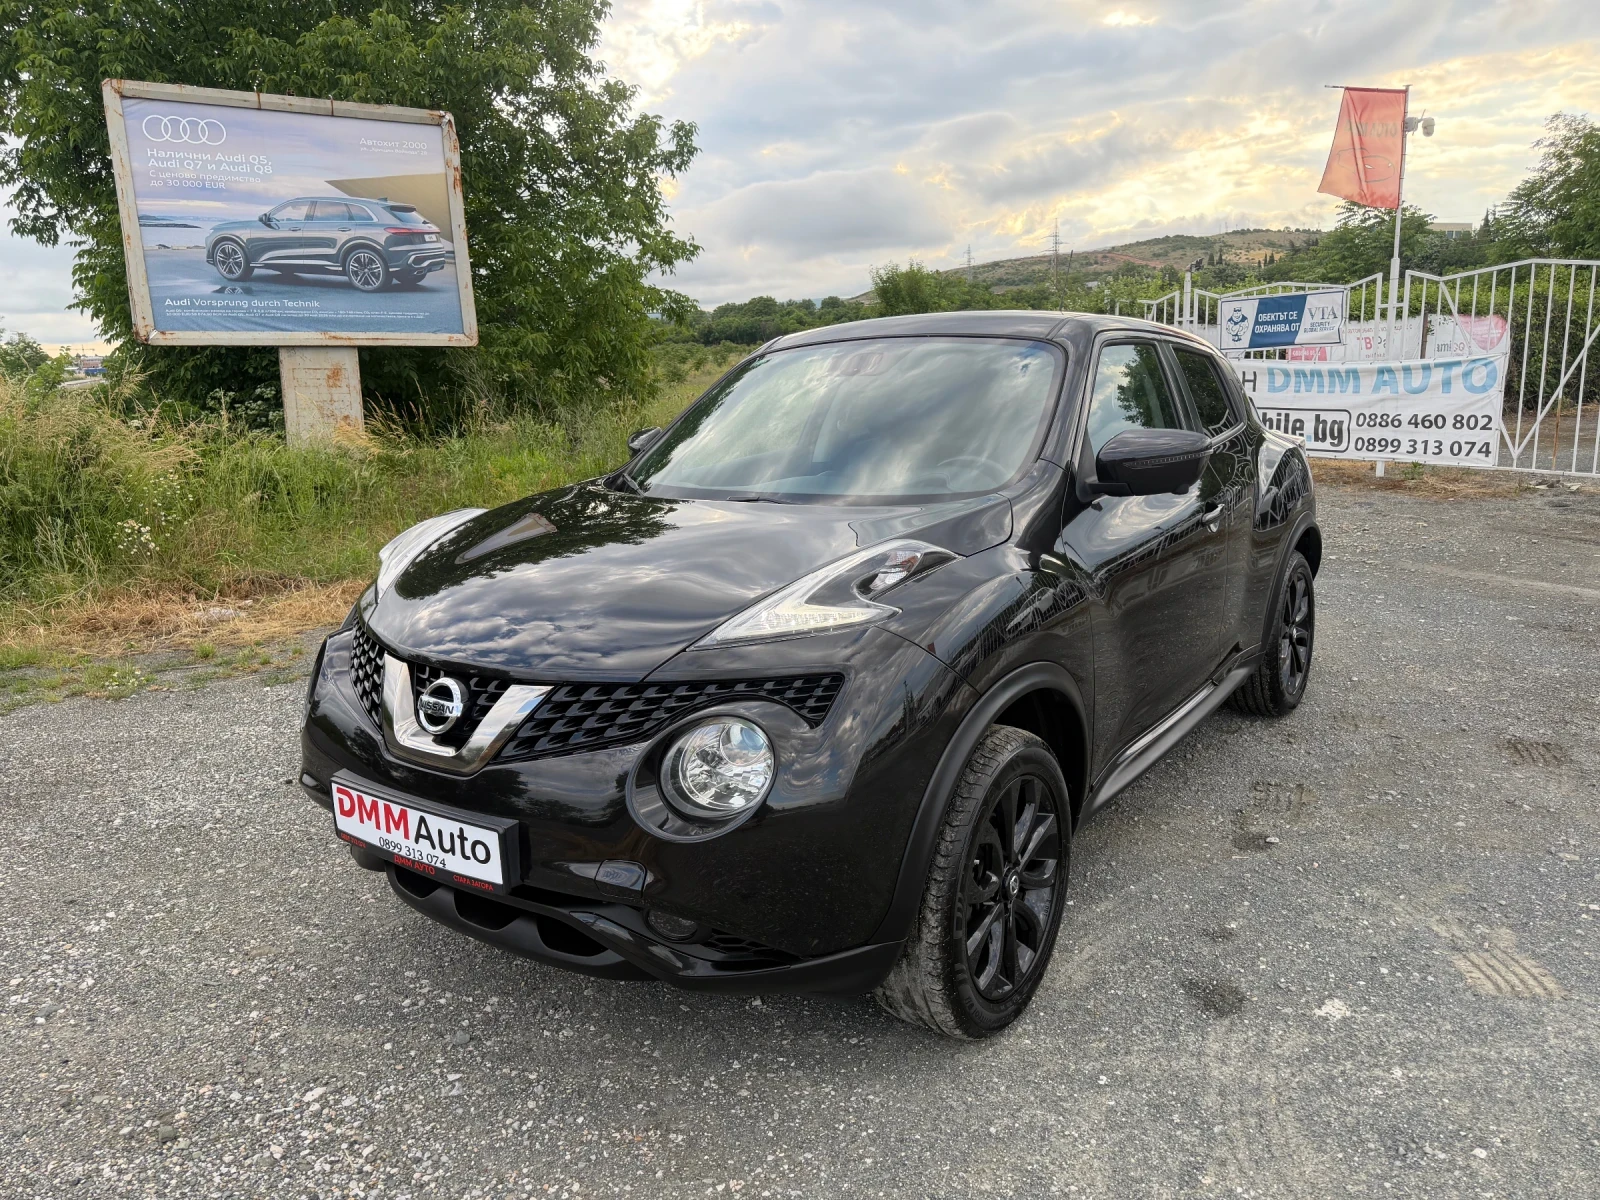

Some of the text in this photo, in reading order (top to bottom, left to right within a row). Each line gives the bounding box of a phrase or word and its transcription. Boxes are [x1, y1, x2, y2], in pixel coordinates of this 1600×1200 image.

[402, 140, 427, 150] 2000
[147, 148, 272, 166] Налични Audi Q5,
[148, 158, 273, 174] Audi Q7 и Audi Q8
[149, 169, 156, 177] С
[159, 171, 197, 179] ценово
[166, 179, 180, 187] 30
[182, 180, 203, 188] 000
[205, 181, 226, 189] EUR
[164, 298, 320, 308] Audi Vorsprung durch Technik
[1258, 311, 1298, 322] ОБЕКТЪТ СЕ
[1306, 305, 1339, 320] VTA
[1254, 322, 1300, 334] ОХРАНЯВА ОТ
[1267, 366, 1361, 394] DMM
[1370, 357, 1498, 395] AUTO
[1355, 412, 1493, 431] 0886 460 802
[1354, 437, 1492, 458] 0899 313 074
[420, 698, 455, 715] NISSAN
[378, 836, 402, 853] 0899
[404, 845, 424, 861] 313
[426, 853, 447, 869] 074
[393, 854, 436, 876] ДММ АУТО
[453, 874, 494, 892] СТАРА ЗАГОРА
